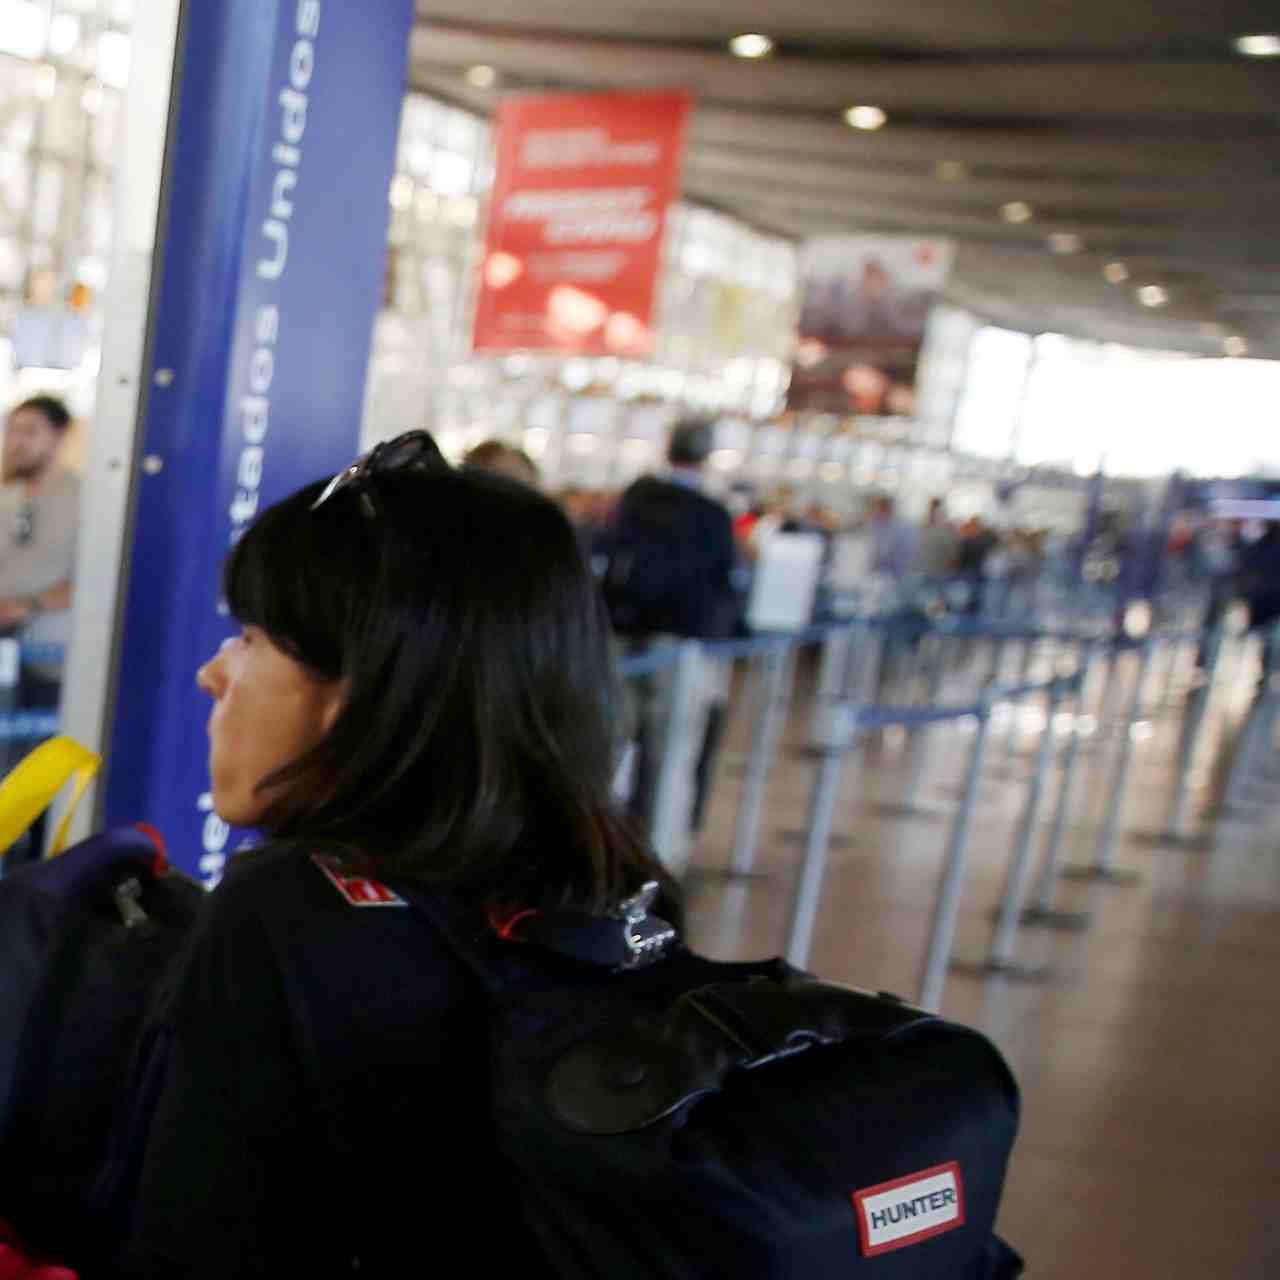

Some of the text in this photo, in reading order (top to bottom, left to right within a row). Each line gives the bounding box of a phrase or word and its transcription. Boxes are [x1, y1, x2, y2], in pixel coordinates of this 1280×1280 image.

[225, 0, 320, 565] tados Unidos
[871, 1187, 956, 1230] HUNTER
